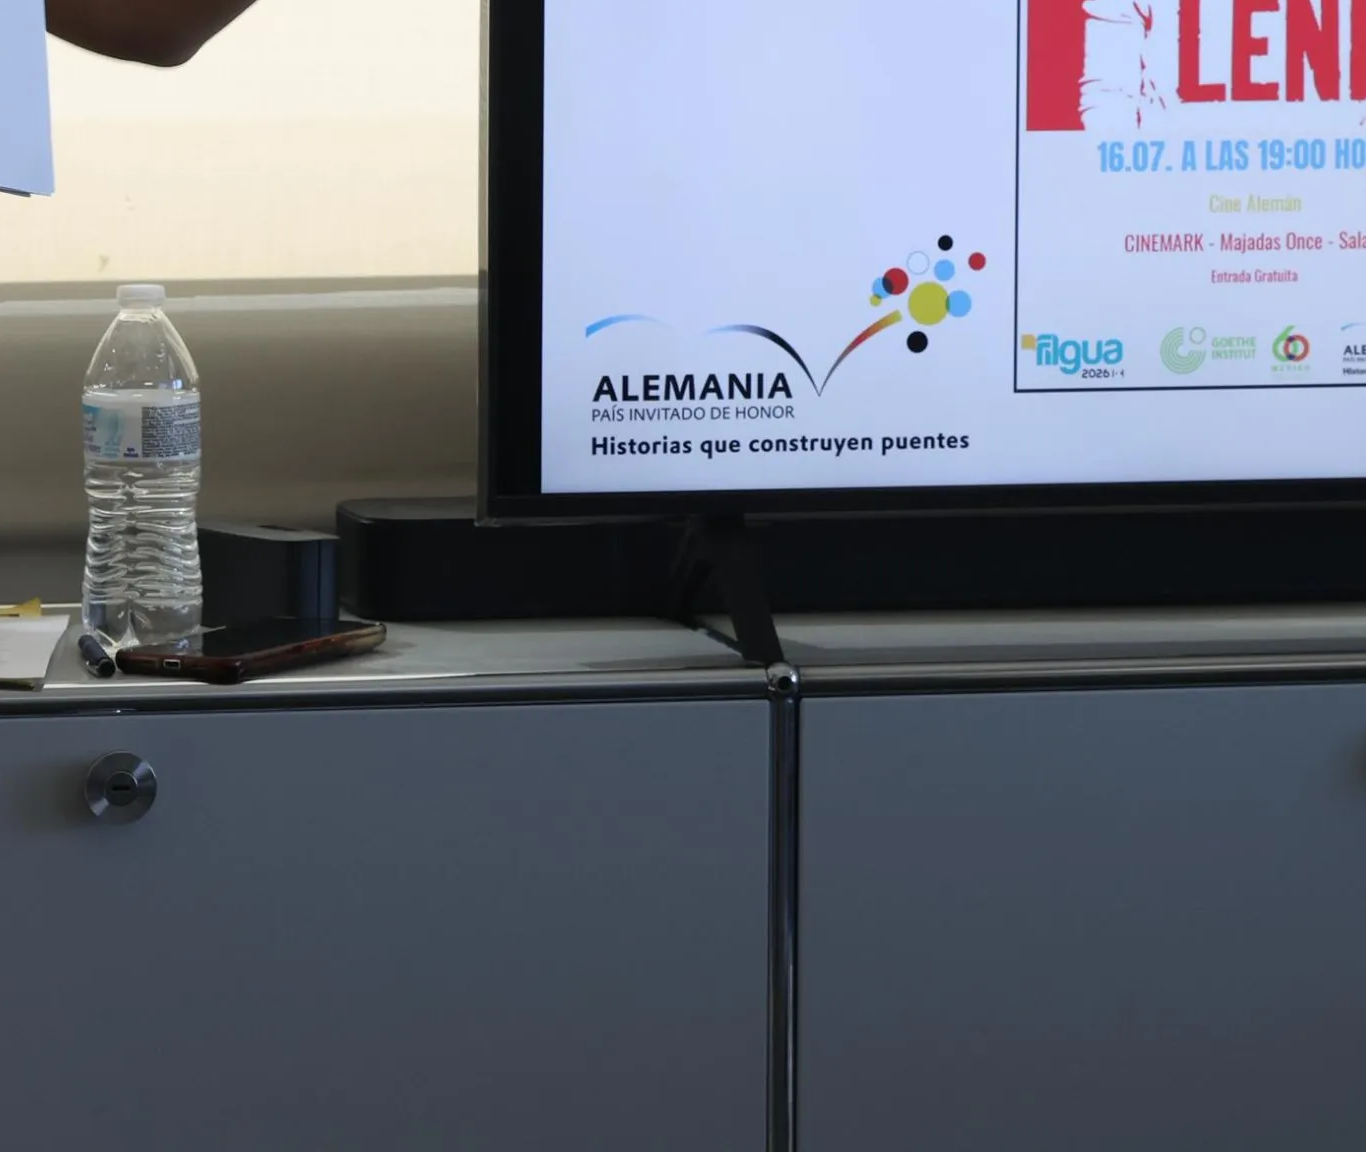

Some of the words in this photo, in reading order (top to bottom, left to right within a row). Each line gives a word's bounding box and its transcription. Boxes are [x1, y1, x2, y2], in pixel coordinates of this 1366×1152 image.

[1097, 140, 1173, 173] 16.07.
[1182, 140, 1196, 171] A
[1205, 140, 1249, 171] LAS
[1258, 139, 1326, 171] 19:00
[1209, 195, 1241, 214] Cine
[1247, 193, 1301, 213] Alemán
[1124, 233, 1203, 253] CINEMARK
[1220, 232, 1281, 253] Majadas
[1286, 231, 1322, 250] Once
[1211, 270, 1251, 284] Entrada
[1254, 269, 1298, 283] Gratuita
[1212, 337, 1256, 347] GOETHE
[1212, 348, 1256, 359] INSTITUT
[1082, 369, 1109, 378] 2026
[593, 373, 793, 403] ALEMANIA
[592, 404, 625, 422] PAÍS
[630, 406, 705, 421] INVITADO
[710, 406, 730, 420] DE
[735, 405, 794, 420] HONOR
[591, 435, 692, 456] Historias
[701, 438, 740, 459] que
[748, 435, 873, 456] construyen
[882, 432, 969, 456] puentes
